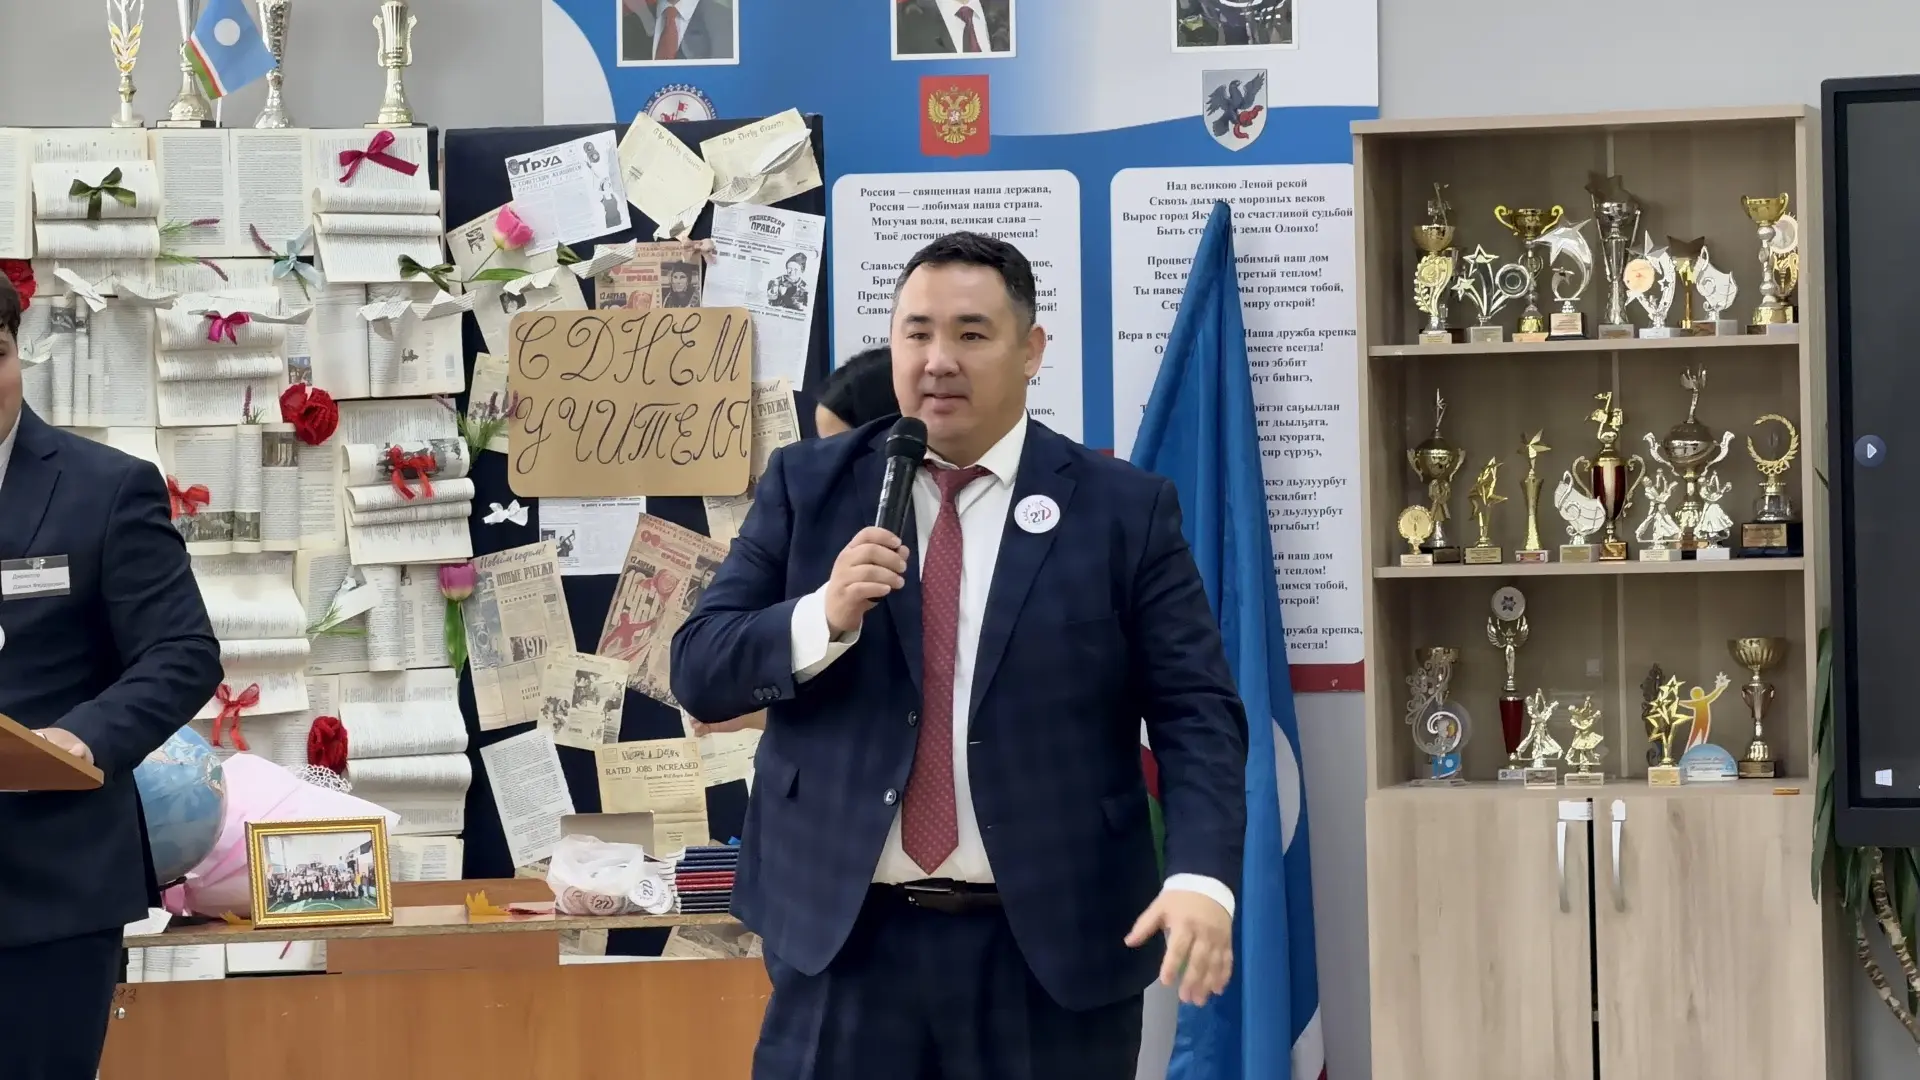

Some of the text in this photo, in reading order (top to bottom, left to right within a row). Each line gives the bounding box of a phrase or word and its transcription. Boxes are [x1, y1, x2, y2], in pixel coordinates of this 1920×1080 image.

[1166, 178, 1308, 191] Над великою Леной рекой
[860, 188, 896, 197] Россия
[913, 187, 970, 197] священная
[973, 187, 1001, 195] наша
[1004, 186, 1052, 196] держава,
[869, 202, 905, 212] Россия
[921, 201, 970, 211] любимая
[972, 202, 1001, 210] наша
[1003, 201, 1043, 211] страна.
[1149, 196, 1188, 206] Сквозь
[1239, 195, 1292, 206] морозных
[1295, 195, 1326, 203] веков
[1122, 212, 1157, 223] Вырос
[1160, 213, 1189, 223] город
[1233, 210, 1245, 219] со
[1247, 208, 1309, 218] счастливой
[1311, 207, 1353, 220] судьбой
[872, 217, 917, 228] Могучая
[920, 217, 948, 226] воля,
[950, 217, 994, 225] великая
[996, 216, 1026, 224] слава
[751, 222, 781, 235] ПРАВДА
[1156, 226, 1186, 236] Быть
[1239, 226, 1272, 234] земли
[1274, 223, 1319, 233] Олонхо!
[874, 231, 898, 241] Твоё
[991, 229, 1038, 240] времена!
[1283, 255, 1306, 263] наш
[1308, 254, 1329, 263] дом
[1154, 271, 1178, 280] Всех
[1280, 267, 1322, 278] теплом!
[1133, 285, 1150, 296] Ты
[1257, 285, 1307, 295] гордимся
[1310, 282, 1344, 293] тобой,
[1243, 300, 1270, 311] миру
[1273, 298, 1316, 310] открой!
[862, 335, 877, 344] От
[1118, 330, 1143, 342] Вера
[1146, 332, 1153, 340] в
[1276, 328, 1315, 340] дружба
[1318, 329, 1357, 340] крепка
[515, 311, 748, 386] С ДНЕМ
[1247, 342, 1324, 353] вместе всегда!
[1271, 358, 1308, 368] эбэбит
[515, 396, 750, 475] УЧИТЕЛЯ
[1279, 433, 1325, 444] куората,
[1262, 449, 1281, 459] сир
[1286, 476, 1348, 489] дьулуурбут
[1282, 506, 1343, 518] дьулуурбут
[1287, 552, 1310, 560] наш
[1312, 552, 1333, 561] дом
[1284, 565, 1326, 575] теплом!
[1314, 580, 1348, 591] тобой,
[1321, 627, 1363, 637] крепка,
[1290, 640, 1329, 650] всегда!
[605, 761, 699, 776] RATED JOBS INCREASED
